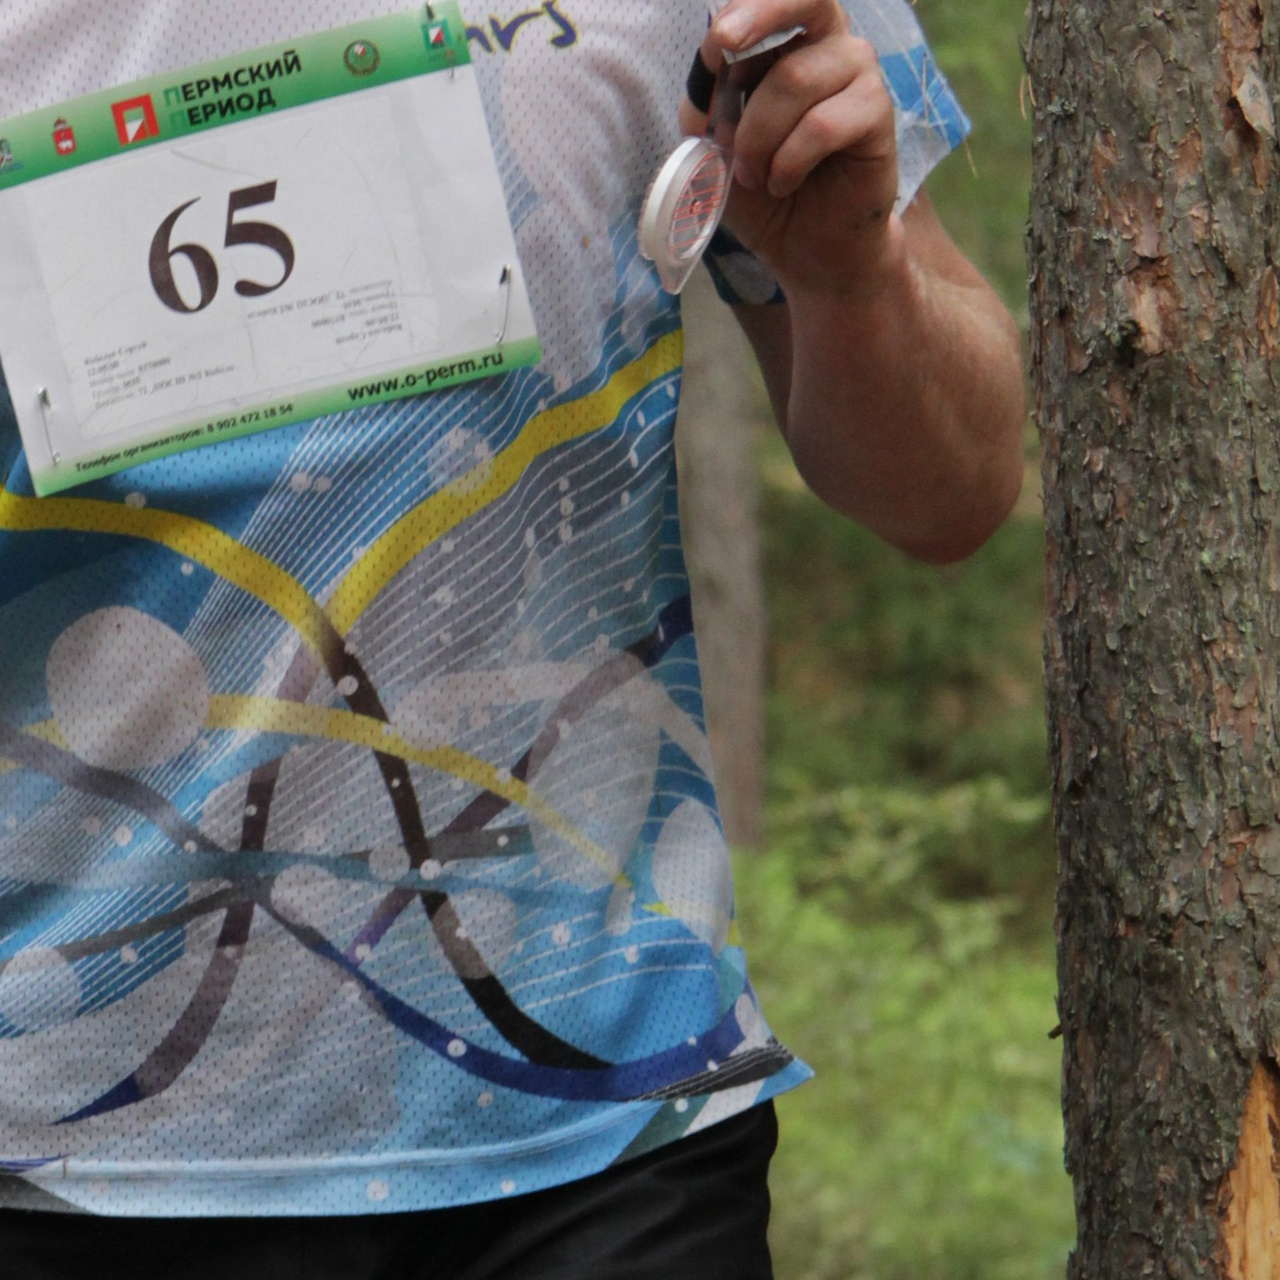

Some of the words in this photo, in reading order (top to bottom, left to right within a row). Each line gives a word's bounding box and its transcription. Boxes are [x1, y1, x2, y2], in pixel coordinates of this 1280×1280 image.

[163, 50, 302, 106] ПЕРМСКИЙ
[169, 87, 276, 128] ПЕРИОД
[148, 179, 296, 315] 65
[348, 352, 503, 400] www.o-perm.ru
[75, 452, 121, 473] Телефон
[123, 427, 205, 458] организаторов:
[206, 422, 215, 433] 8
[217, 416, 237, 430] 902
[239, 411, 261, 425] 472
[263, 407, 276, 419] 18
[278, 402, 293, 415] 54
